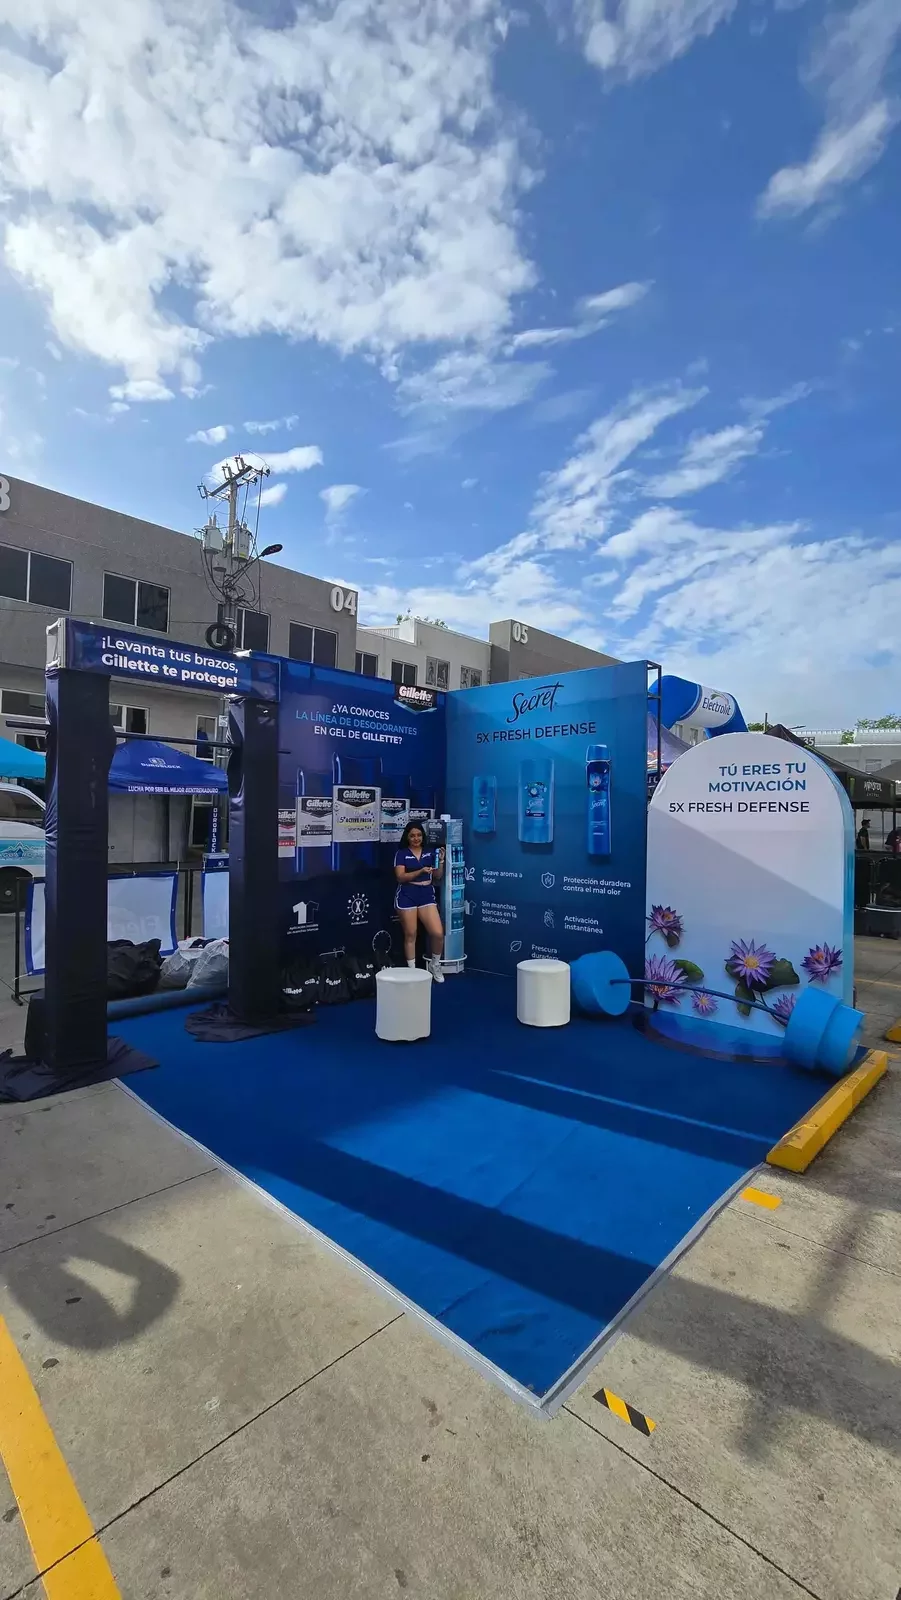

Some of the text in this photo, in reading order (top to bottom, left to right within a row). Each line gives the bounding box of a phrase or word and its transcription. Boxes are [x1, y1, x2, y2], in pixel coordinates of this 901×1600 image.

[330, 586, 356, 616] 04
[512, 623, 528, 644] 05
[102, 635, 239, 674] ¡Levanta tus brazos,
[102, 654, 238, 688] Gillette te protege!
[399, 685, 433, 701] Gillette
[506, 681, 565, 724] Secret
[702, 697, 732, 716] Electrolit
[332, 704, 390, 720] ¿YA CONOCES
[296, 710, 418, 736] LA LÍNEA DE DESODORANTES
[314, 725, 403, 744] EN GEL DE GILLETTE?
[476, 722, 597, 744] 5X FRESH DEFENSE
[719, 762, 806, 776] TÚ ERES TU
[708, 777, 806, 792] MOTIVACIÓN
[343, 790, 371, 799] Gillette
[306, 799, 332, 808] Gillette
[669, 801, 810, 812] 5X FRESH DEFENSE
[278, 811, 296, 819] illett
[482, 869, 500, 877] Suave
[563, 876, 631, 888] Protección duradera
[563, 885, 584, 893] contra
[482, 909, 501, 917] blancas
[491, 902, 517, 911] manchas
[482, 916, 510, 925] aplicación
[564, 915, 599, 925] Activación
[564, 923, 603, 934] instantánea
[531, 943, 558, 954] Frescura
